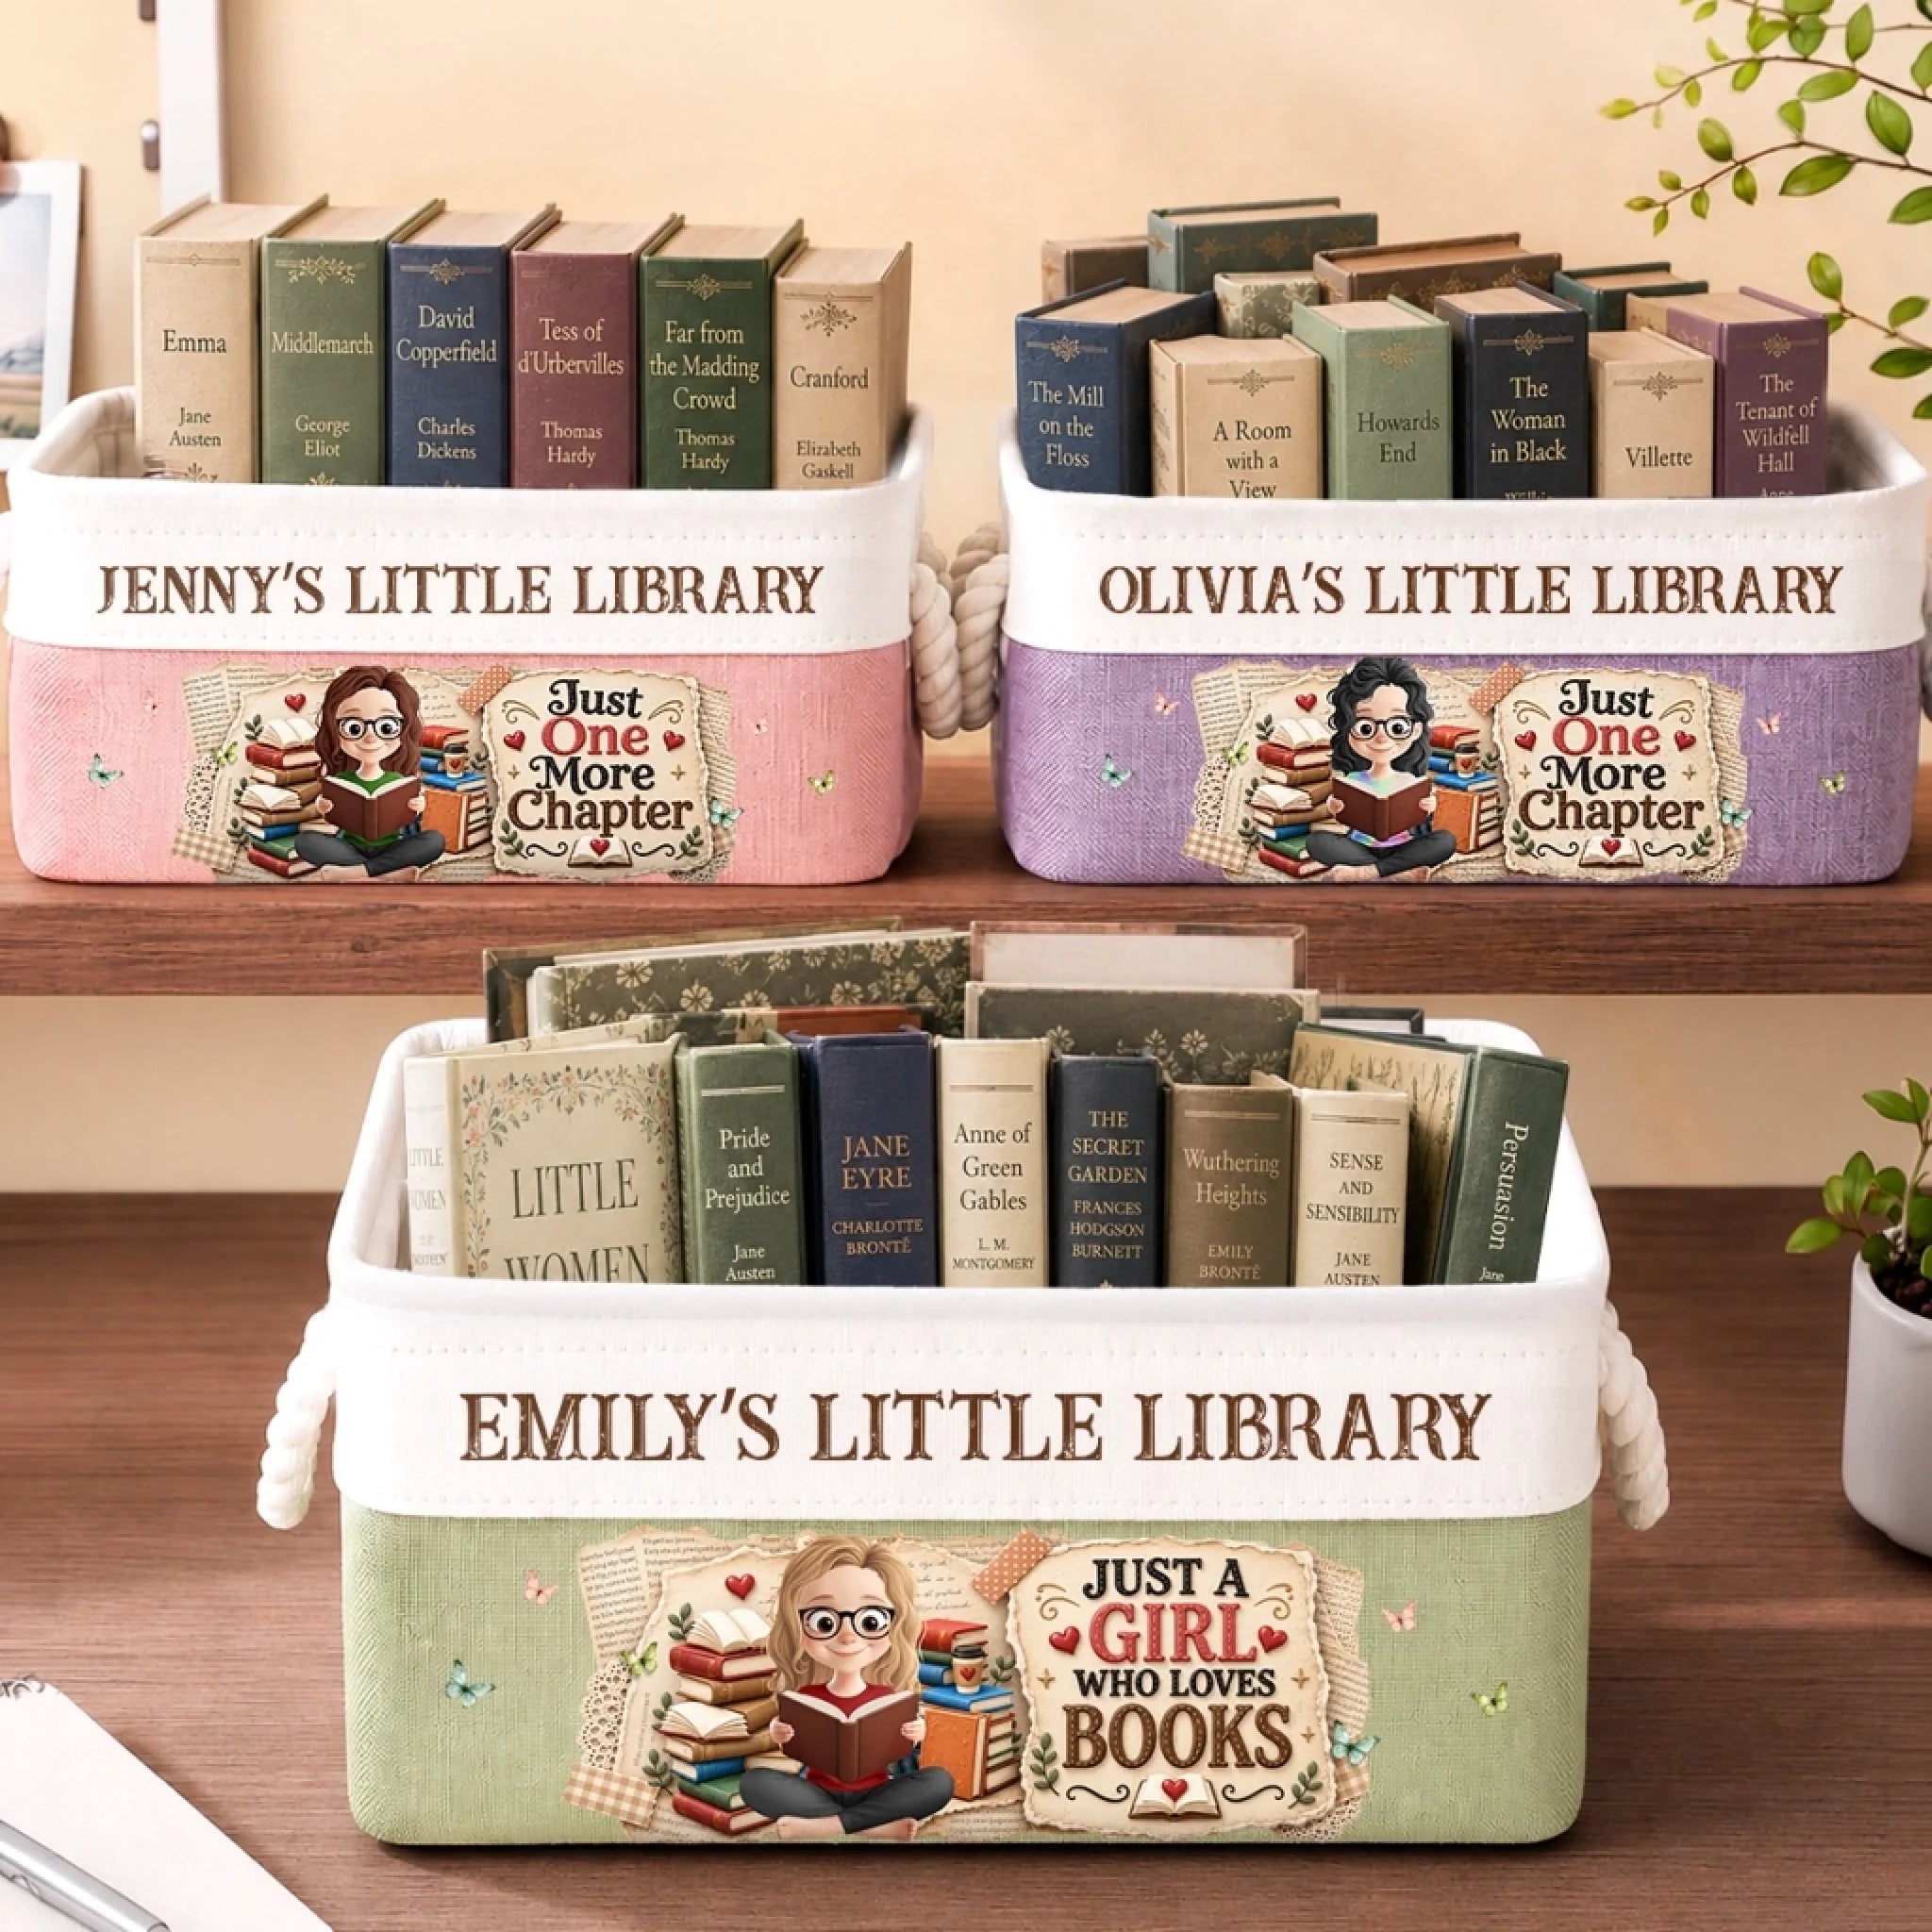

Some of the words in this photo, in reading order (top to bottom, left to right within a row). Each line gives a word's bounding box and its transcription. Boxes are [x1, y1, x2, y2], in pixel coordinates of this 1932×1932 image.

[418, 306, 475, 329] David
[540, 318, 578, 341] Tess
[583, 318, 605, 341] of
[665, 321, 694, 345] Far
[700, 321, 744, 345] from
[162, 329, 227, 354] Emma
[272, 332, 375, 355] Middlemarch
[395, 339, 497, 368] Copperfield
[518, 351, 625, 375] d'Urbervilles
[650, 353, 677, 376] the
[682, 353, 760, 383] Madding
[790, 366, 869, 389] Cranford
[1028, 381, 1062, 405] The
[1067, 384, 1105, 408] Mill
[1510, 376, 1549, 399] The
[1759, 374, 1794, 393] The
[674, 387, 736, 410] Crowd
[1736, 400, 1794, 421] Tenant
[1799, 397, 1819, 418] of
[178, 407, 211, 426] Jane
[295, 415, 350, 438] George
[418, 417, 475, 437] Charles
[1039, 417, 1062, 436] on
[1066, 413, 1093, 438] the
[1357, 409, 1441, 432] Howards
[1491, 408, 1566, 430] Woman
[169, 429, 222, 448] Austen
[541, 421, 603, 440] Thomas
[675, 427, 735, 446] Thomas
[1213, 421, 1228, 442] A
[1235, 421, 1292, 441] Room
[1742, 425, 1809, 446] Wildfell
[304, 440, 341, 458] Eliot
[417, 441, 476, 459] Dickens
[547, 446, 596, 468] Hardy
[796, 440, 861, 458] Elizabeth
[1045, 444, 1090, 469] Floss
[1225, 449, 1265, 470] with
[1269, 456, 1279, 469] a
[1379, 443, 1416, 463] End
[1491, 442, 1508, 463] in
[1515, 440, 1567, 463] Black
[1625, 446, 1693, 469] Villette
[682, 453, 730, 474] Hardy
[801, 462, 854, 480] Gaskell
[1757, 452, 1794, 473] Hall
[1229, 479, 1278, 498] View
[96, 561, 325, 614] JENNY'S
[345, 563, 552, 614] LITTLE
[573, 565, 824, 614] LIBRARY
[1099, 561, 1345, 614] OLIVIA'S
[1364, 563, 1571, 614] LITTLE
[1591, 565, 1844, 614] LIBRARY
[547, 678, 643, 719] Just
[1558, 678, 1655, 719] Just
[541, 716, 649, 757] One
[1553, 716, 1660, 757] One
[528, 756, 656, 794] More
[1540, 756, 1666, 794] More
[508, 790, 693, 838] Chapter
[1518, 790, 1705, 838] Chapter
[1089, 1110, 1128, 1128] THE
[719, 1126, 771, 1149] Pride
[954, 1123, 1007, 1143] Anne
[1012, 1122, 1033, 1143] of
[841, 1135, 910, 1165] JANE
[1072, 1138, 1144, 1156] SECRET
[727, 1155, 764, 1178] and
[962, 1156, 1024, 1178] Green
[1183, 1148, 1280, 1178] Wuthering
[1329, 1152, 1384, 1172] SENSE
[841, 1166, 912, 1190] EYRE
[1067, 1165, 1148, 1184] GARDEN
[1488, 1122, 1529, 1250] Persuasion
[510, 1158, 639, 1219] LITTLE
[1195, 1182, 1267, 1209] Heights
[1339, 1180, 1374, 1195] AND
[705, 1185, 791, 1214] Prejudice
[959, 1189, 1027, 1211] Gables
[1073, 1200, 1142, 1215] FRANCES
[1306, 1203, 1401, 1224] SENSIBILITY
[831, 1219, 924, 1235] CHARLOTTE
[1069, 1222, 1144, 1237] HODGSON
[732, 1244, 765, 1262] Jane
[1071, 1243, 1144, 1259] BURNETT
[1208, 1244, 1254, 1259] EMILY
[1334, 1252, 1372, 1268] JANE
[504, 1243, 650, 1283] WOMEN
[725, 1266, 776, 1281] Austen
[952, 1257, 1036, 1271] MONTGOMERY
[1324, 1274, 1380, 1287] AUSTEN
[459, 1387, 780, 1461] EMILY'S
[809, 1389, 1103, 1461] LITTLE
[1133, 1392, 1492, 1461] LIBRARY
[1082, 1557, 1203, 1599] JUST
[1213, 1557, 1250, 1599] A
[1089, 1602, 1257, 1664] GIRL
[1074, 1668, 1160, 1697] WHO
[1170, 1668, 1276, 1697] LOVES
[1061, 1704, 1293, 1770] BOOKS
